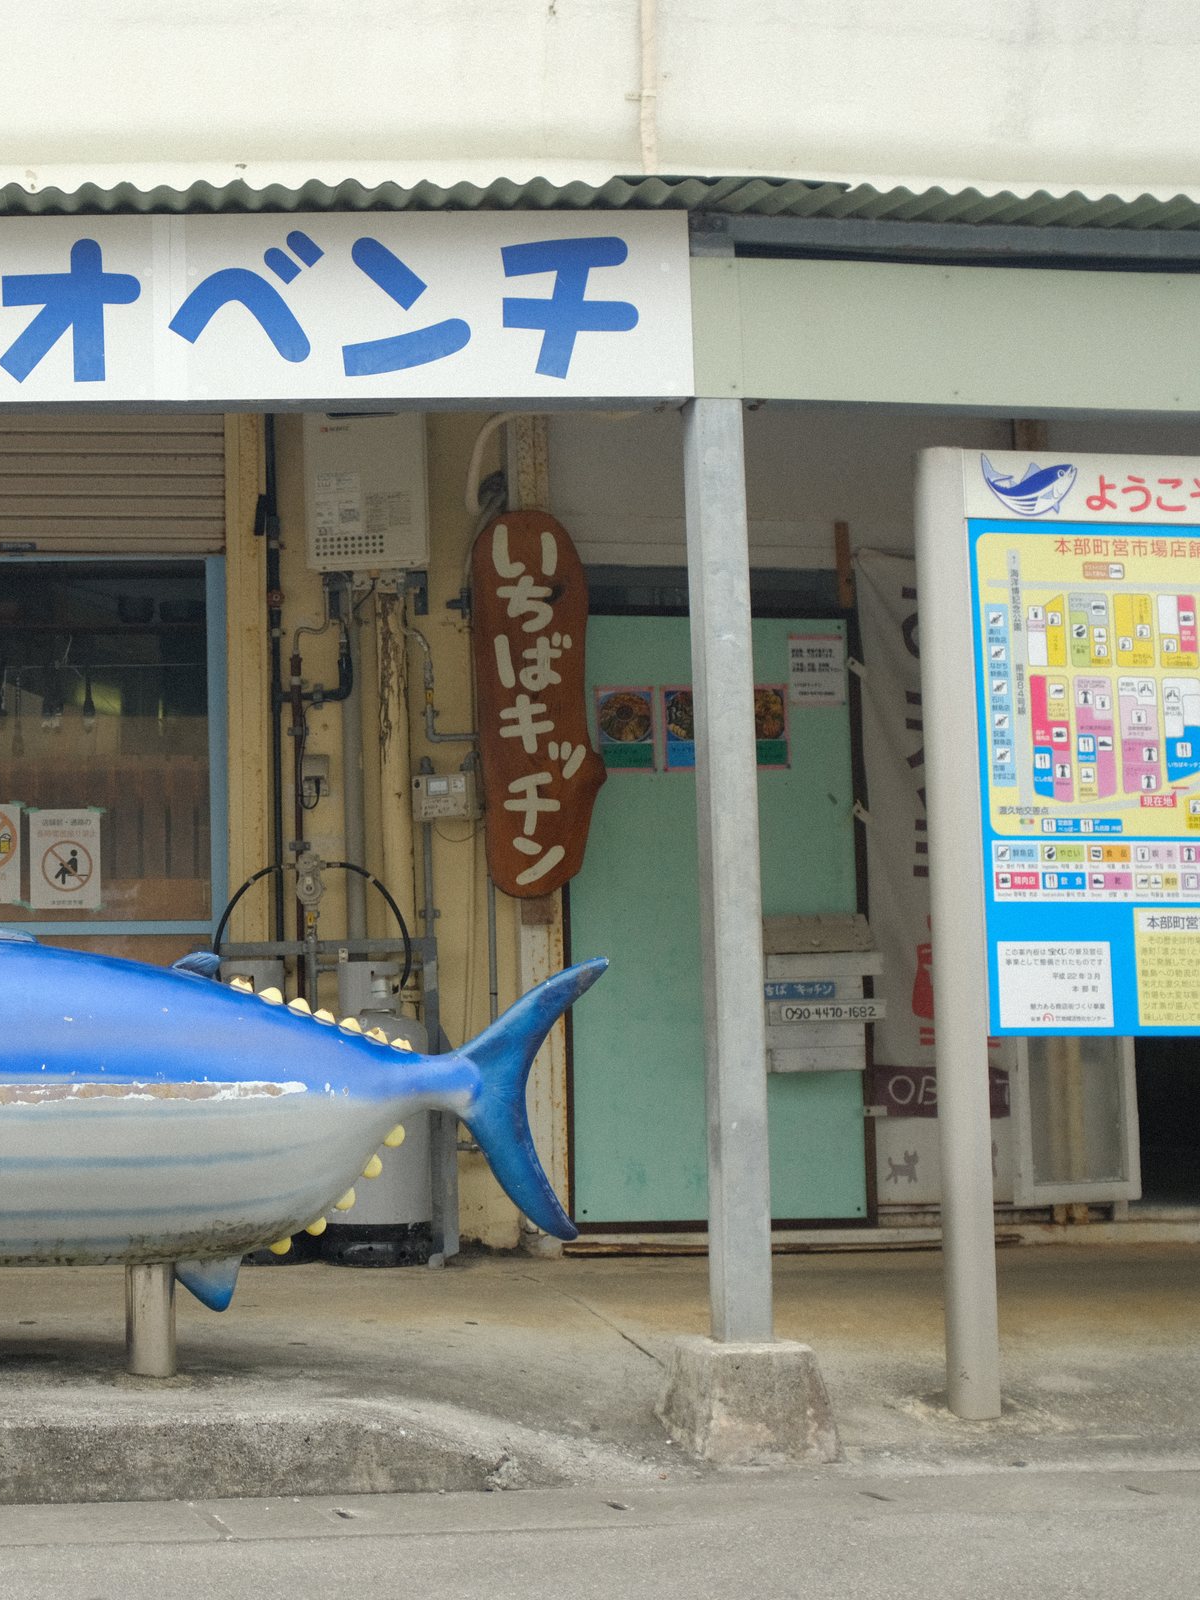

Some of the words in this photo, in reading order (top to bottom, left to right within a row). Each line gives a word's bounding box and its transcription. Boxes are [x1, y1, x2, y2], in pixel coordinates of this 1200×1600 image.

[492, 524, 586, 886] いちばキッチン
[1143, 795, 1173, 807] 現在地
[1146, 915, 1200, 930] 本部町営
